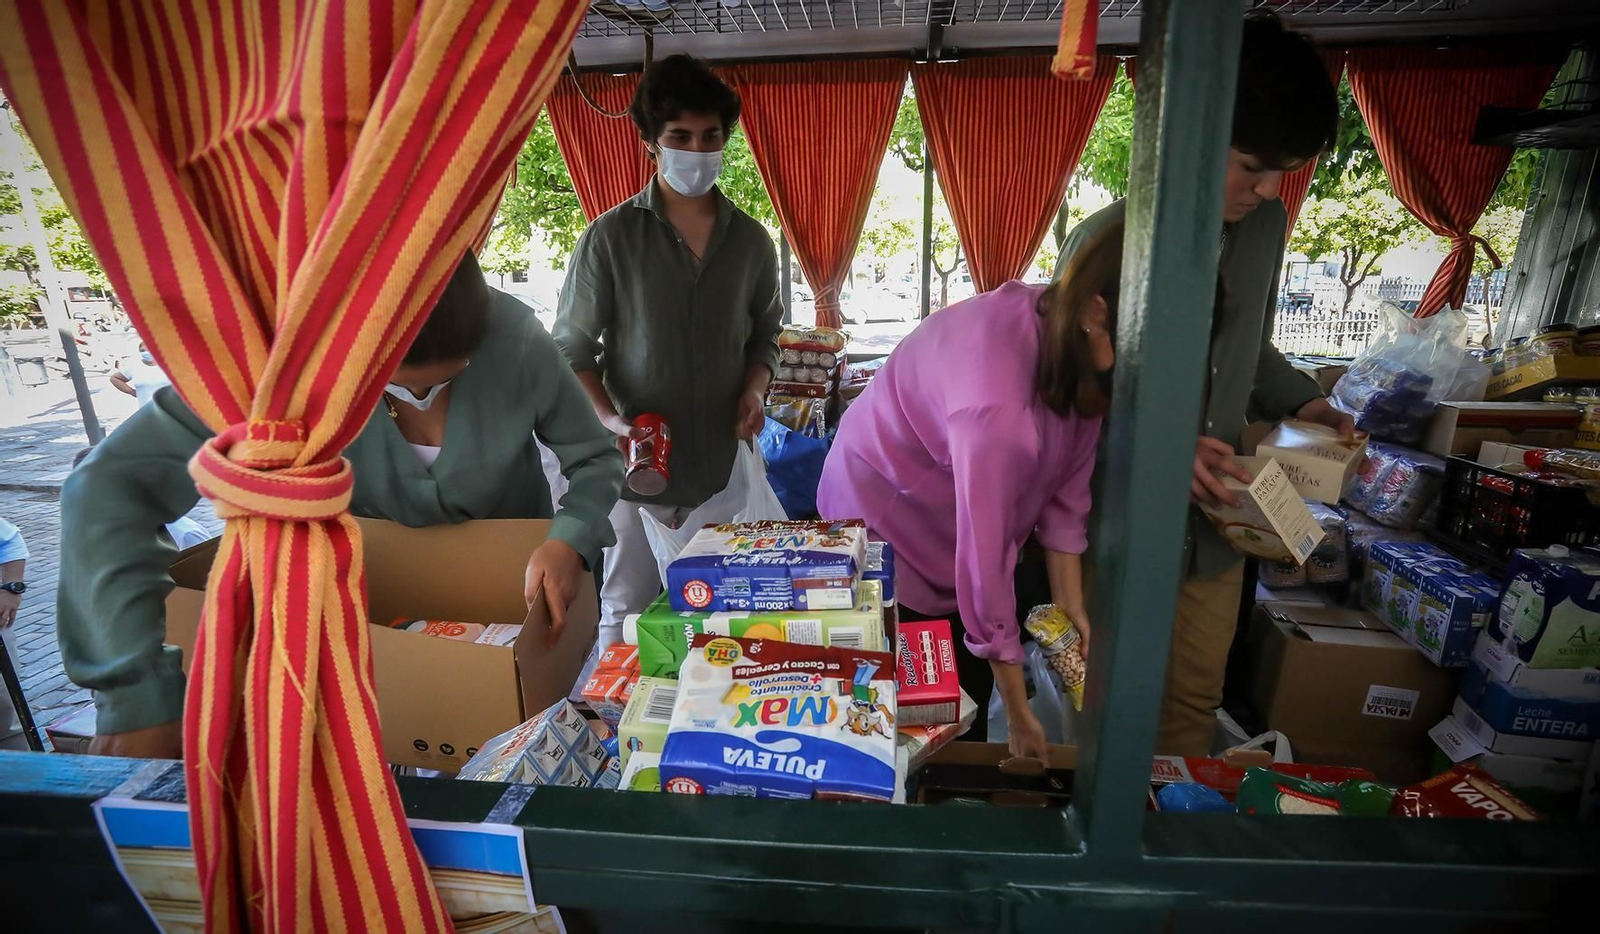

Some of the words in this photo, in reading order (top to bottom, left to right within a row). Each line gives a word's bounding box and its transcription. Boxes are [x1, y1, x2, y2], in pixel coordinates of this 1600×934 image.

[1502, 373, 1523, 389] CACAO
[1575, 430, 1595, 442] OTES
[1257, 470, 1282, 501] PATATAS
[708, 648, 739, 659] DHA
[735, 663, 781, 677] Cereales
[781, 659, 790, 669] y
[790, 660, 825, 671] Cacao
[826, 662, 840, 671] con
[748, 675, 810, 688] Desarrollo
[750, 684, 822, 696] Crecimiento
[734, 695, 830, 729] Max
[1366, 703, 1398, 716] PASTA
[1517, 705, 1552, 718] Leche
[1512, 716, 1590, 737] ENTERA
[722, 746, 826, 781] PULEVA
